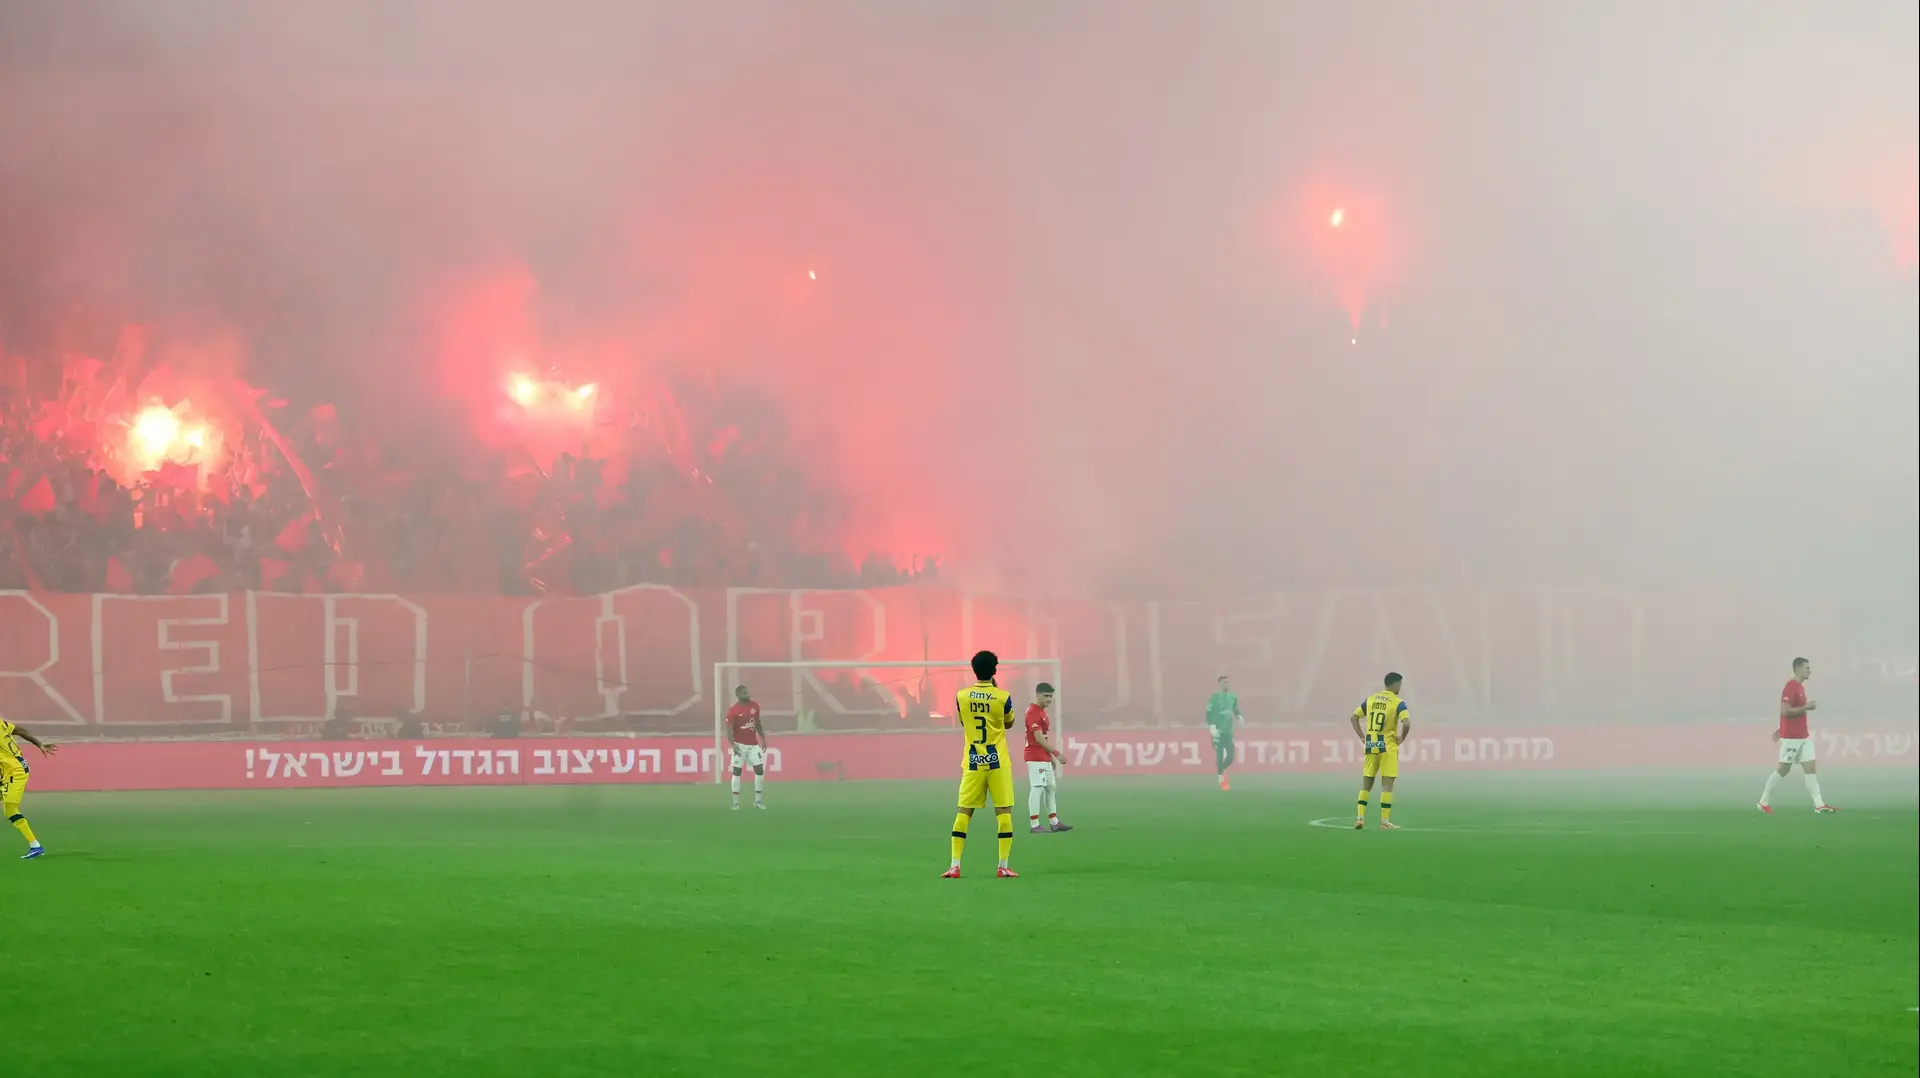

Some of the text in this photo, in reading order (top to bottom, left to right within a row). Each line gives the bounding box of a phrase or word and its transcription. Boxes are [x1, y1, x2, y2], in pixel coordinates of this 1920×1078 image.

[523, 582, 898, 718] OR
[973, 716, 987, 744] 3
[1369, 712, 1386, 732] 19
[244, 744, 784, 780] מחם העיצוב הגדול בישראל!
[1224, 739, 1310, 767] הגדו
[1322, 738, 1443, 764] העוב
[1453, 736, 1556, 763] מתחם
